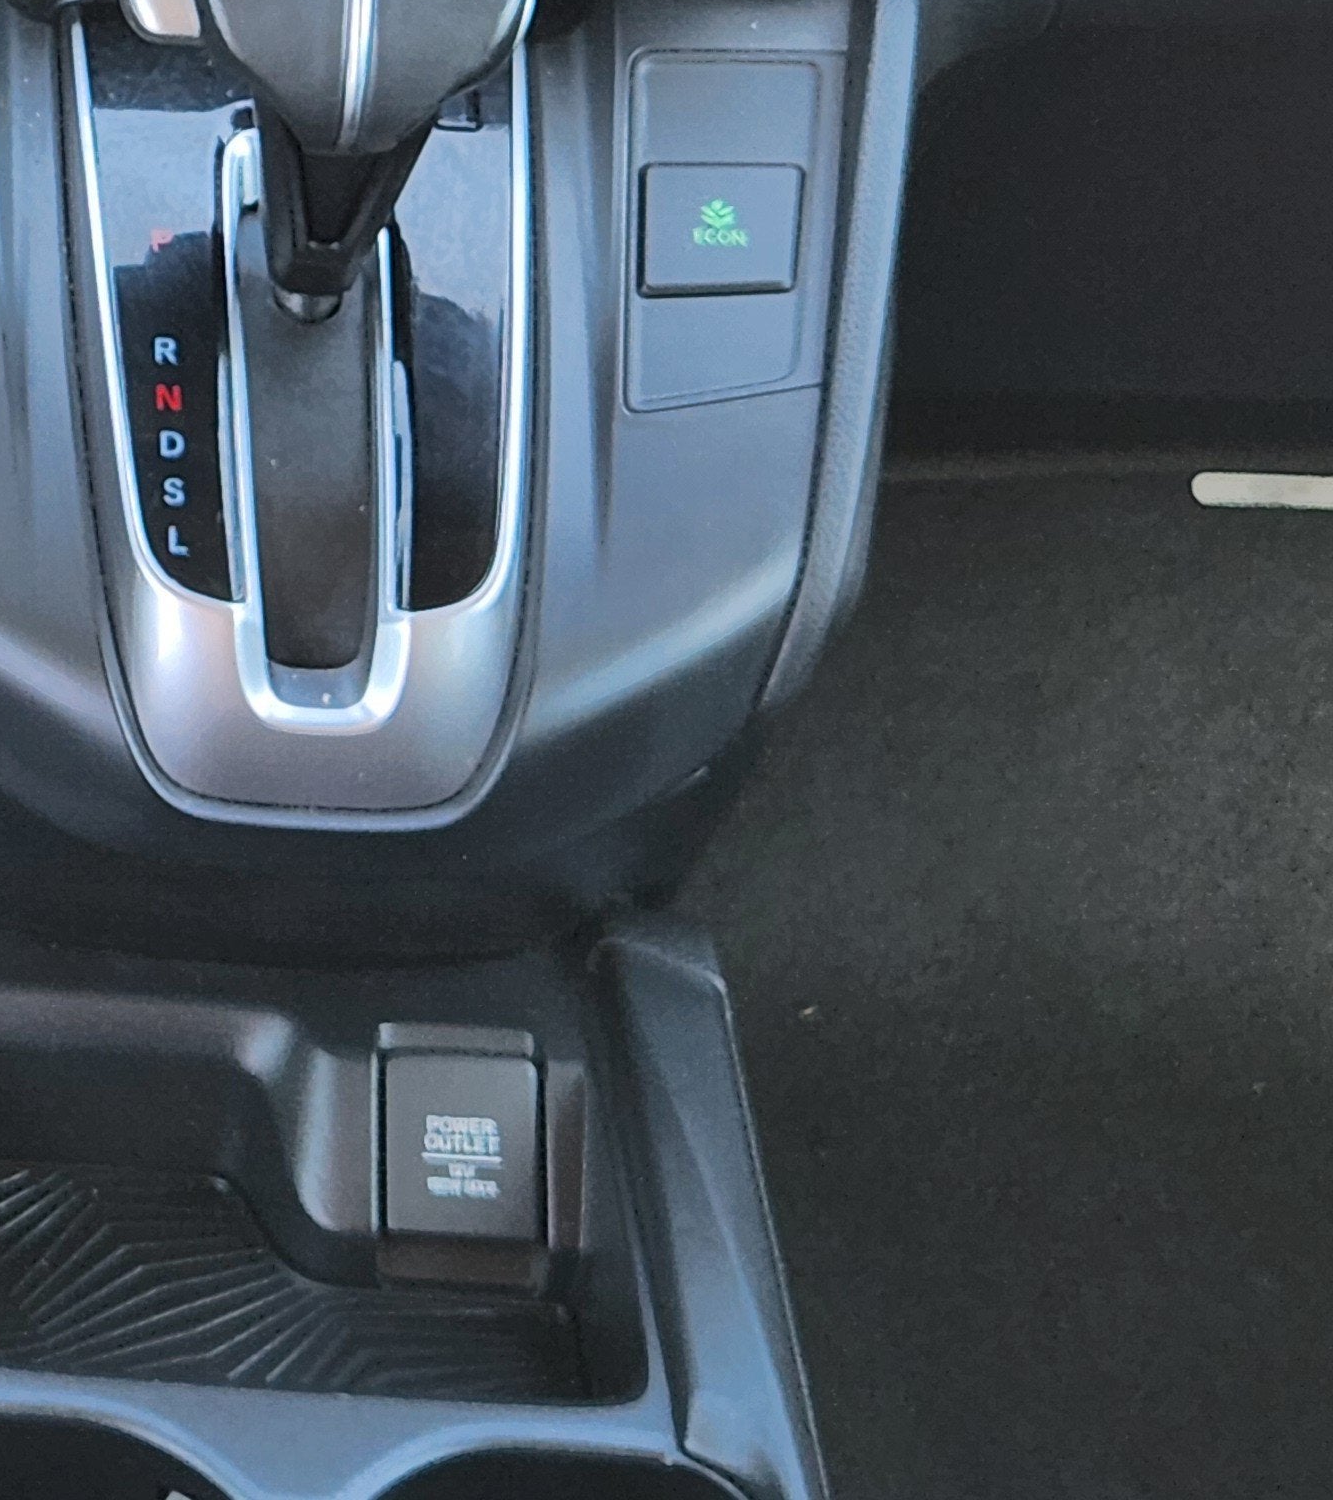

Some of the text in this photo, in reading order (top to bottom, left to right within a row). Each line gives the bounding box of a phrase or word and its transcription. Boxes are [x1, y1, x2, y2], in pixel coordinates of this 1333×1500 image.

[150, 227, 173, 252] P
[691, 227, 749, 247] ECON
[153, 336, 179, 367] R
[154, 384, 183, 411] N
[159, 430, 185, 459] D
[162, 475, 186, 505] S
[167, 524, 190, 557] L
[425, 1114, 498, 1136] POWER
[423, 1133, 501, 1155] OUTLET
